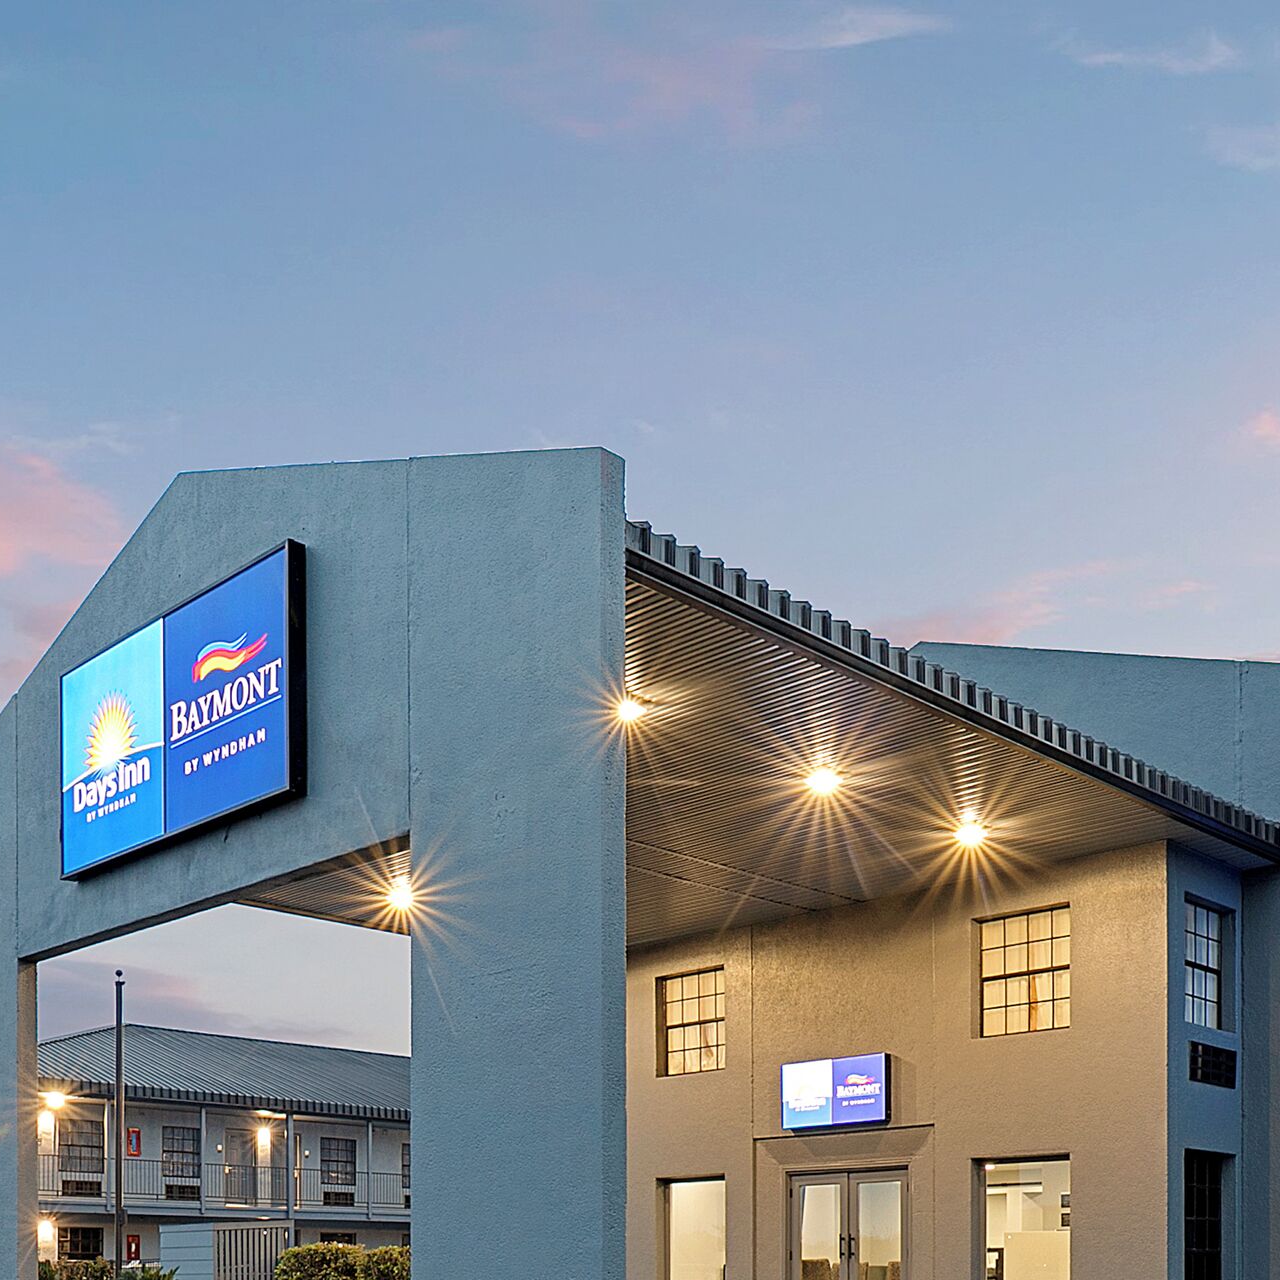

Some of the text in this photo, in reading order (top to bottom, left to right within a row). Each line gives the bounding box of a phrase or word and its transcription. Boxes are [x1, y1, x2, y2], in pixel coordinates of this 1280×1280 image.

[170, 657, 282, 741] BAYMONT
[184, 728, 266, 775] BY WYNDHAM
[73, 757, 151, 813] Days Inn
